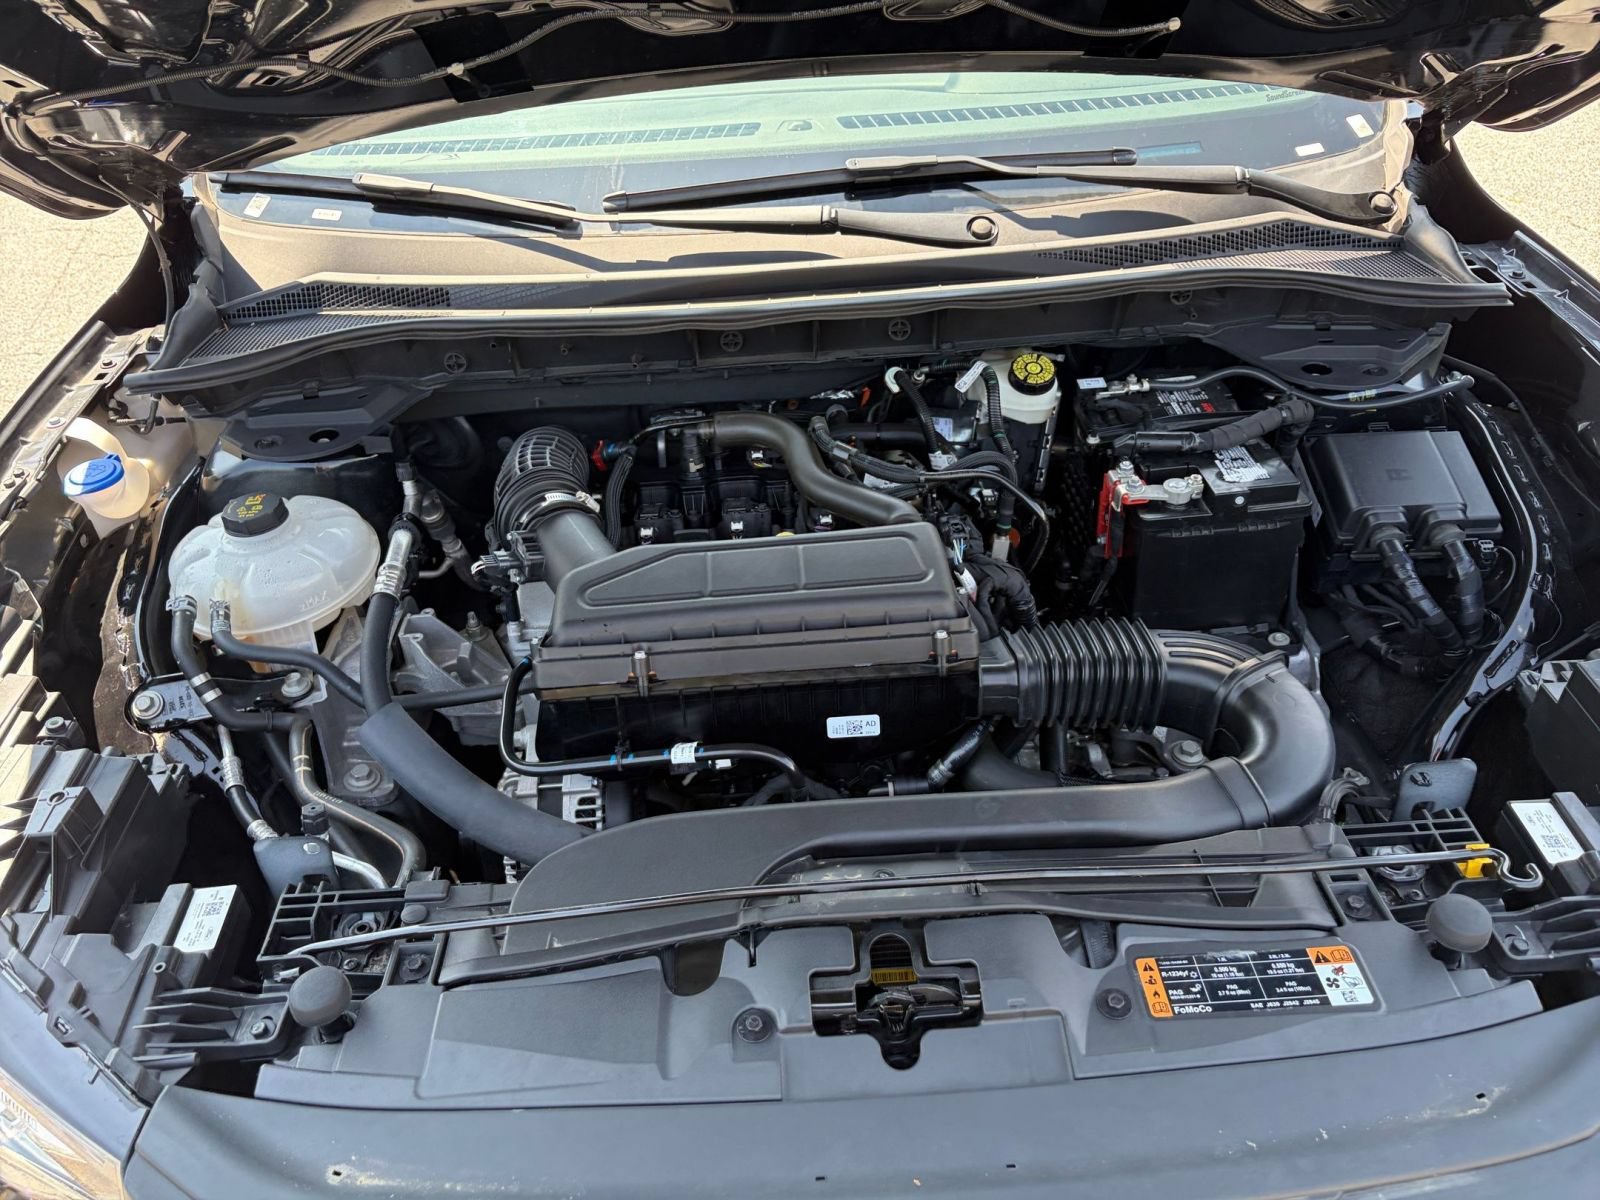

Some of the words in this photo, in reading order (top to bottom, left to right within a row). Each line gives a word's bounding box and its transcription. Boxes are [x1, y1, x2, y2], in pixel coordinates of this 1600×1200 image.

[1228, 965, 1238, 973] kg
[1286, 962, 1295, 970] kg
[1161, 970, 1189, 978] R-1234yf
[1173, 1004, 1212, 1015] FoMoCo
